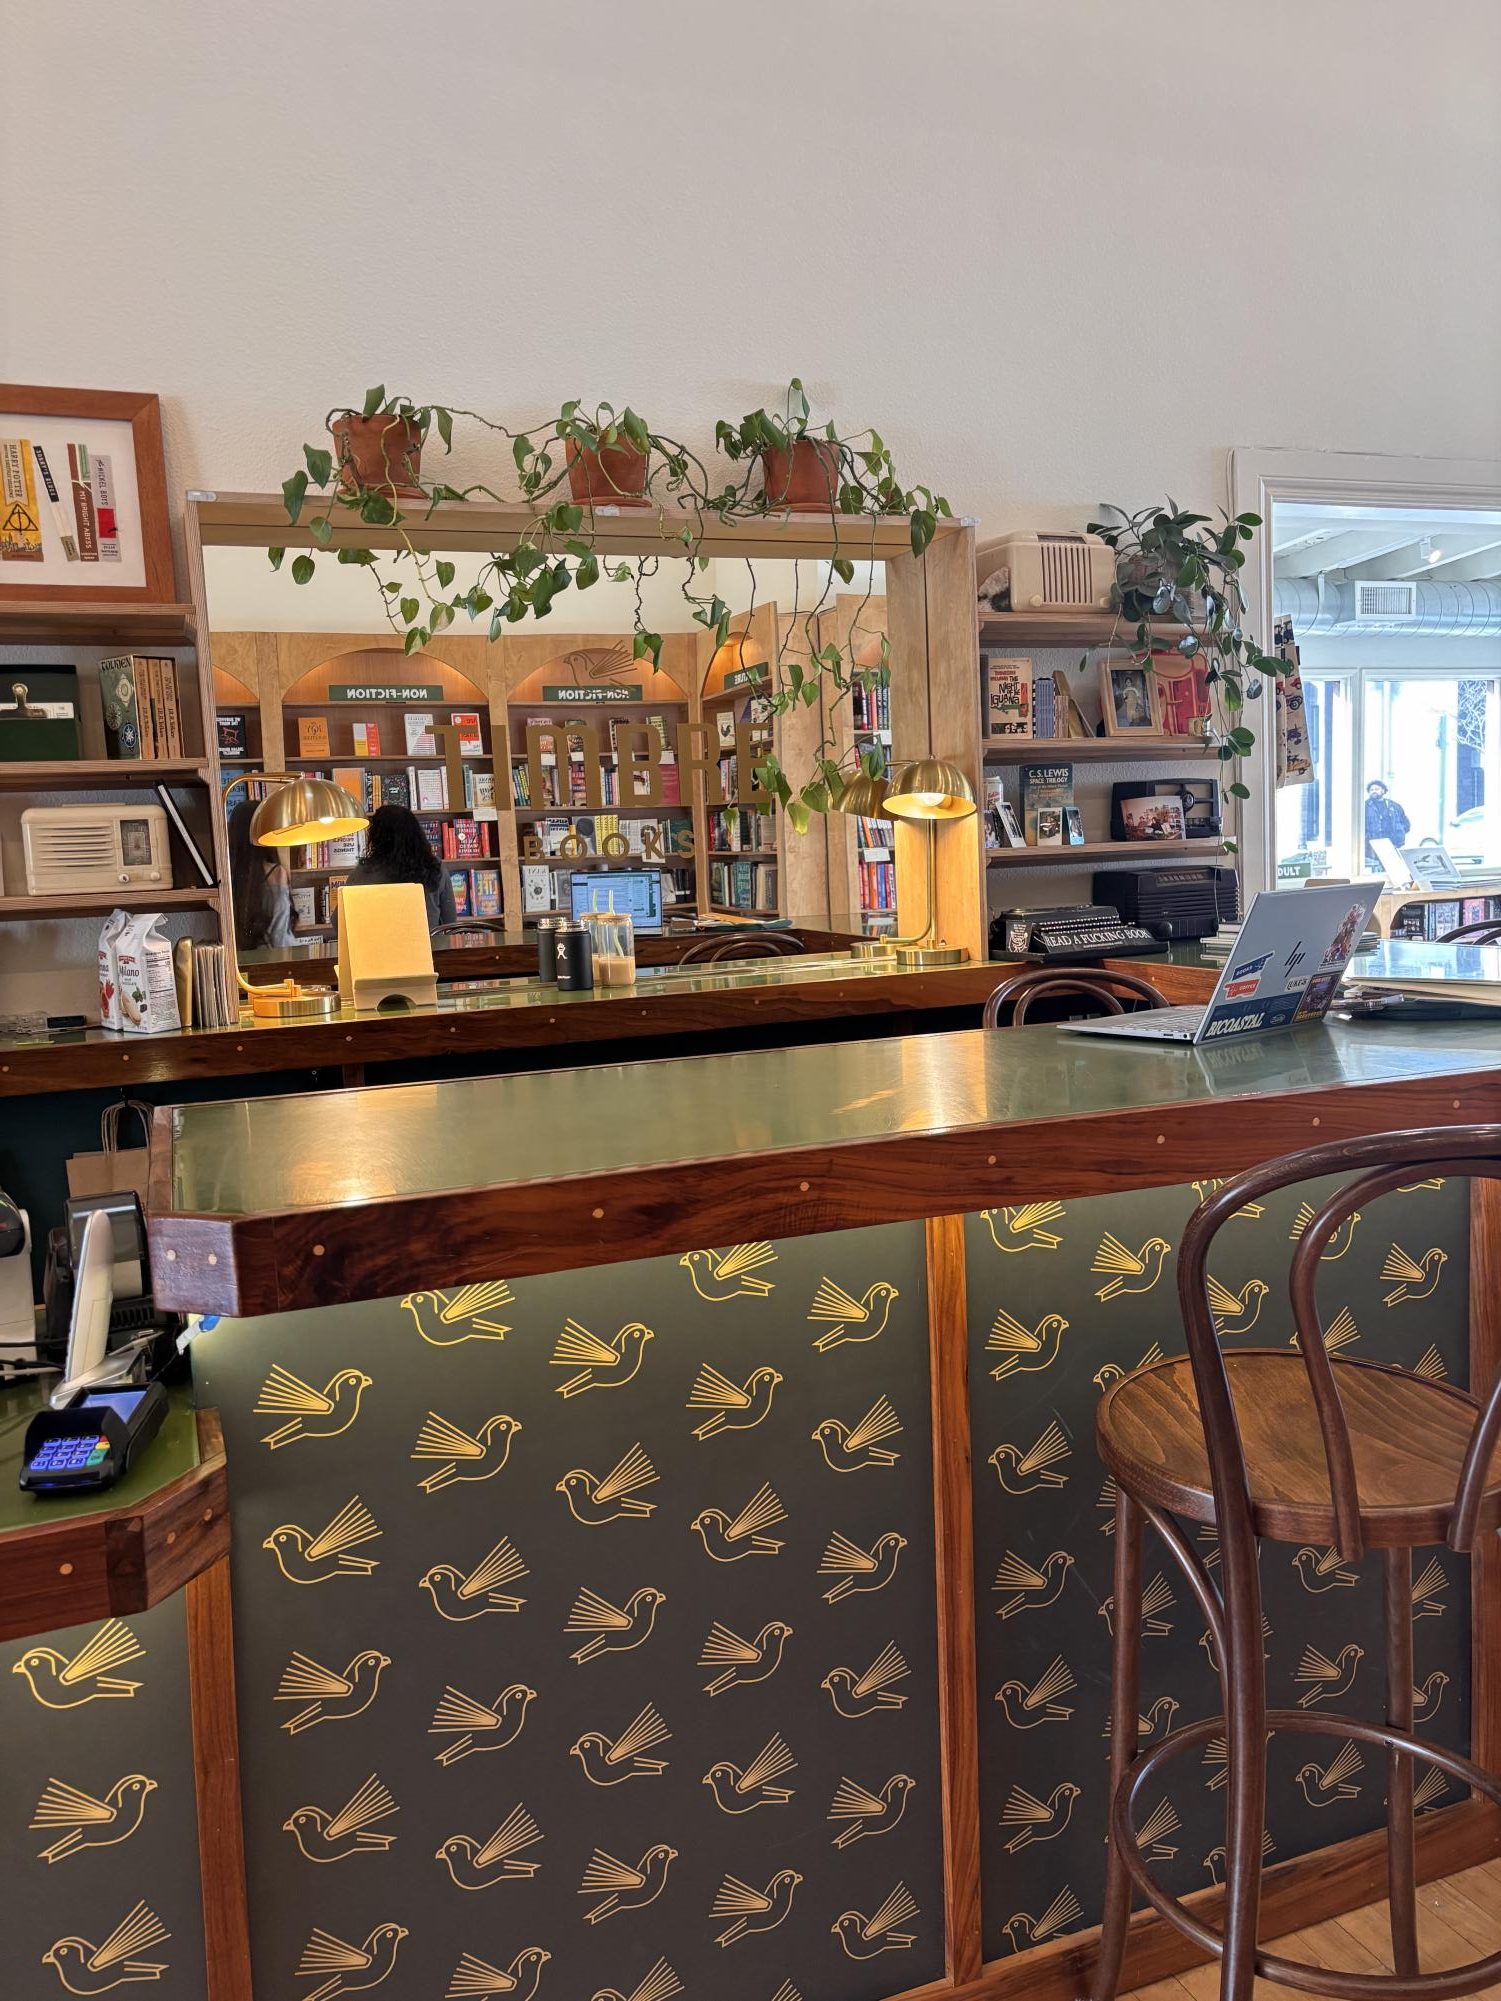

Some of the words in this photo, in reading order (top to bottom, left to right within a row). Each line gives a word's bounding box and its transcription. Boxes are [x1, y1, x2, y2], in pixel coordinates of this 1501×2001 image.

[9, 444, 20, 468] HARRY
[12, 470, 23, 498] POTTER
[44, 477, 56, 497] BLUES
[97, 467, 107, 489] NICKEL
[79, 490, 87, 501] MY
[100, 489, 109, 506] BOYS
[80, 502, 90, 526] BRIGHT
[84, 527, 92, 549] ABYSS
[101, 656, 131, 671] TOLKIEN
[425, 723, 771, 811] TIMBRE
[1044, 768, 1069, 777] LEWIS
[523, 830, 695, 864] BOOKS
[1277, 865, 1301, 877] DULT
[1045, 933, 1071, 947] READ
[1074, 934, 1081, 945] A
[1082, 929, 1124, 944] FUCKING
[1126, 927, 1152, 940] BOOK
[1205, 1012, 1266, 1037] BICOASTAL
